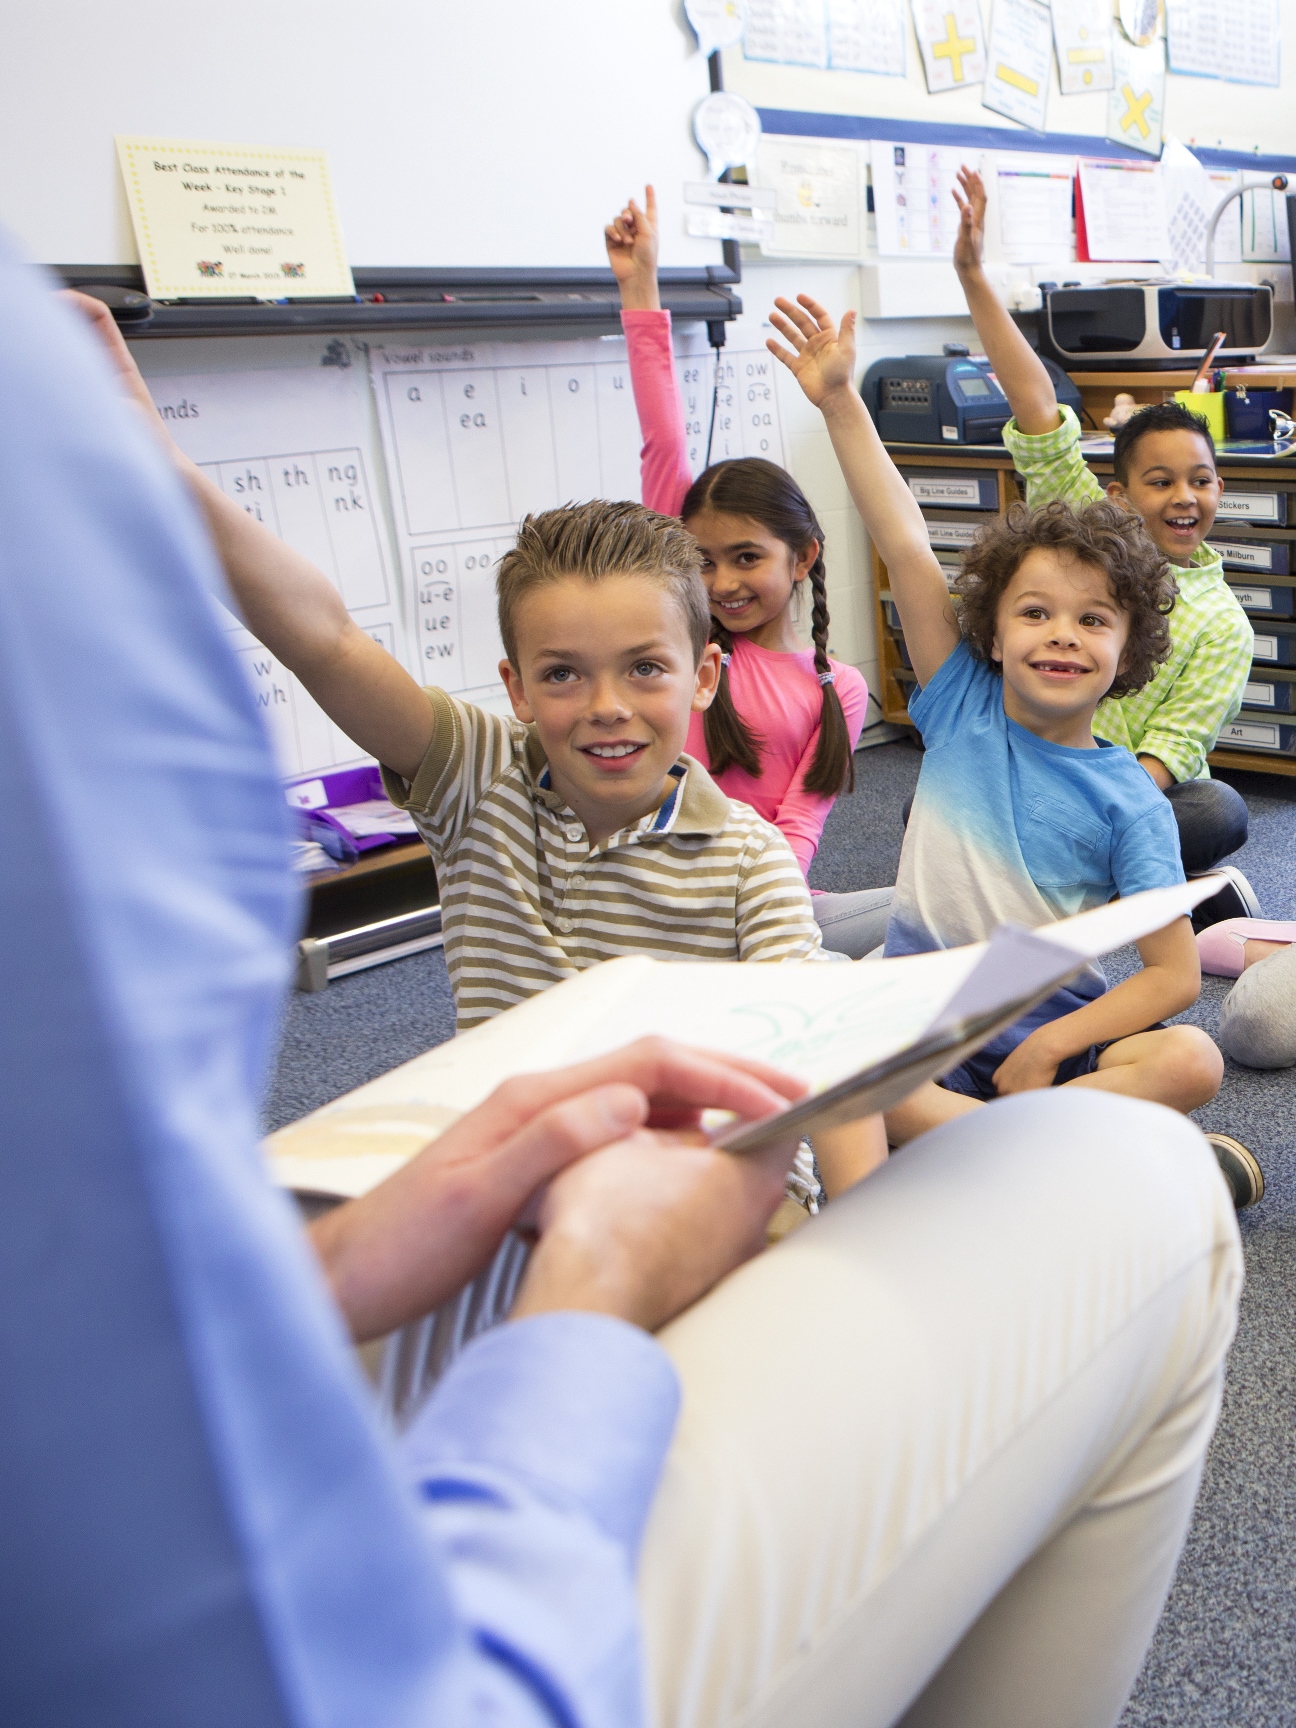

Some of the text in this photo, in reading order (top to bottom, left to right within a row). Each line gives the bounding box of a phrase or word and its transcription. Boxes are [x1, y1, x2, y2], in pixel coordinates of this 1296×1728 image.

[153, 161, 306, 180] Best Class Attendance of the
[181, 181, 213, 192] Week
[225, 183, 244, 197] Key
[248, 185, 277, 198] Stage
[202, 203, 246, 214] Awarded
[249, 205, 259, 215] to
[191, 222, 295, 237] For 100% attendance
[222, 244, 246, 255] Well
[382, 348, 475, 364] Vowel sounds
[683, 368, 699, 383] ee
[746, 362, 768, 376] ow
[407, 375, 624, 402] a e i o u
[688, 396, 697, 414] y
[747, 387, 771, 402] o-e
[460, 411, 487, 428] ea
[719, 416, 731, 430] ie
[752, 413, 772, 427] oa
[690, 447, 698, 461] e
[759, 438, 769, 451] o
[233, 463, 358, 493] sh th ng
[919, 486, 968, 497] Big Line Guides
[334, 489, 364, 513] nk
[1218, 500, 1250, 510] Stickers
[940, 529, 953, 538] Line
[955, 530, 974, 539] Guide
[1226, 549, 1255, 561] Milburn
[420, 553, 490, 576] oo oo
[420, 586, 454, 605] u-e
[425, 614, 451, 632] ue
[425, 642, 455, 660] ew
[253, 659, 273, 677] w
[1230, 727, 1243, 737] Art
